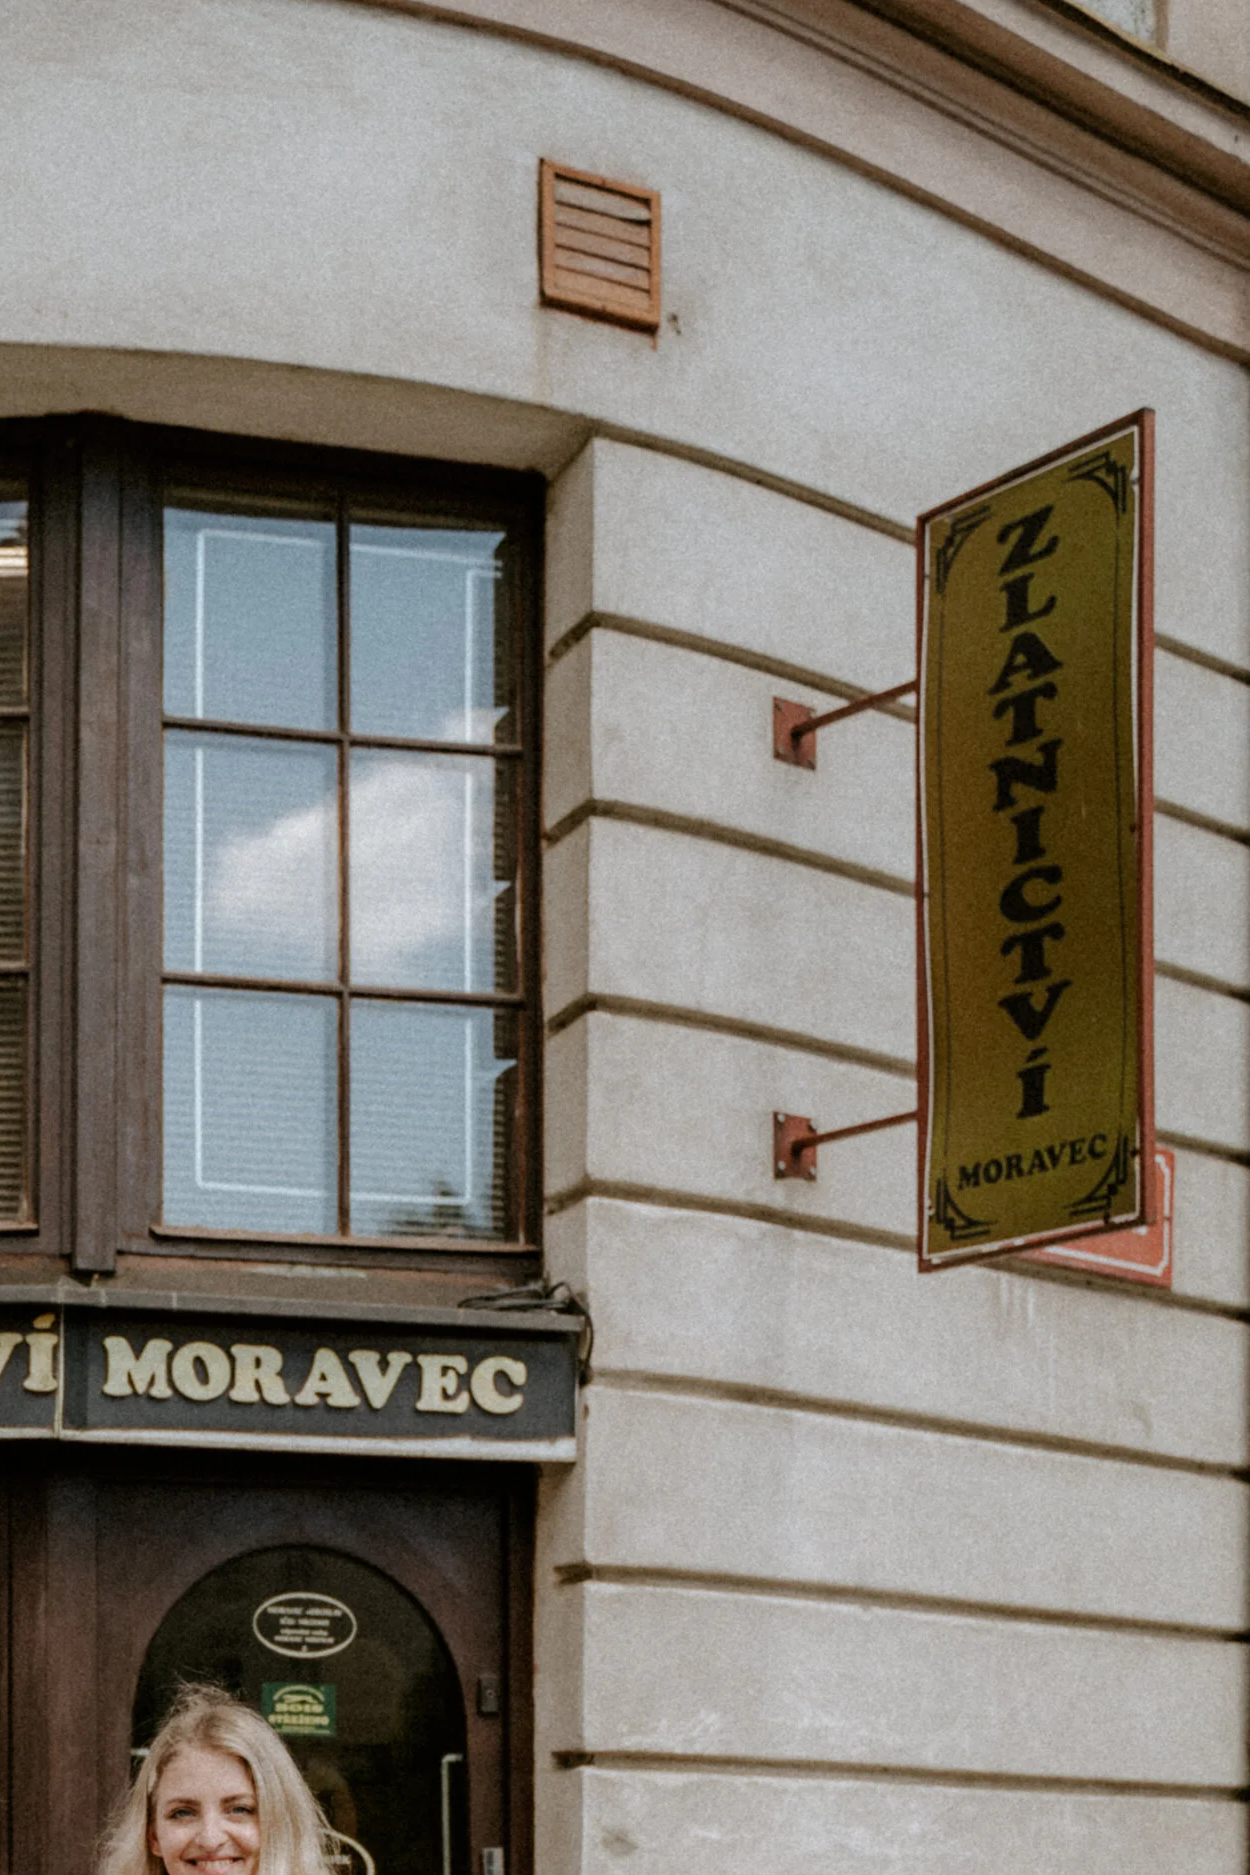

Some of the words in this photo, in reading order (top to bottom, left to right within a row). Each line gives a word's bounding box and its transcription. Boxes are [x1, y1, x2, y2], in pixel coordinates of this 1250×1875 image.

[986, 504, 1073, 1119] ZLATNICTVÍ
[957, 1133, 1108, 1192] MORAVEC
[102, 1335, 529, 1416] MORAVEC
